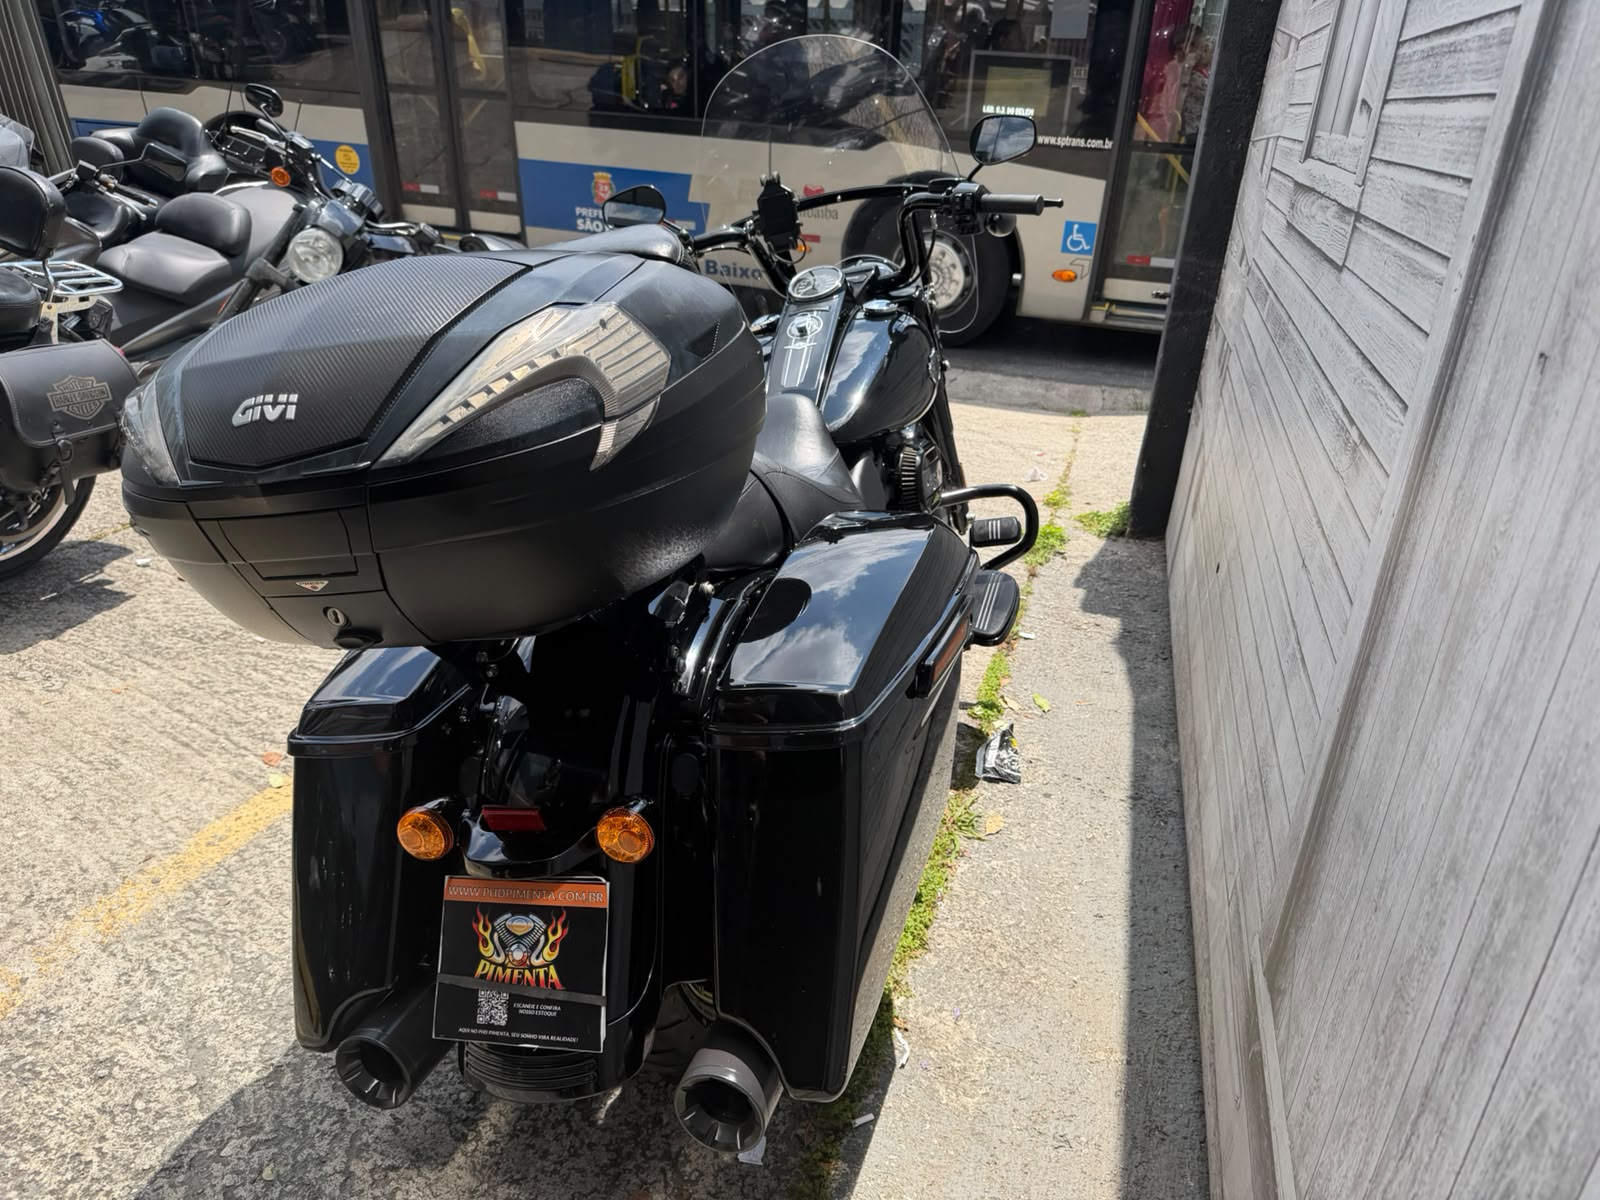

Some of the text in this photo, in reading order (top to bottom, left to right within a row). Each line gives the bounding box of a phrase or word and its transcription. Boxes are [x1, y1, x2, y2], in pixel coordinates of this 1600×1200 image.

[1037, 134, 1113, 150] www.sptrans.com.br
[576, 219, 603, 233] SÃO
[705, 259, 763, 281] Baixo
[231, 393, 299, 428] GIVI
[448, 886, 603, 902] WWW.PHDPIMENTA.COM.BR
[474, 958, 565, 990] PIMENTA
